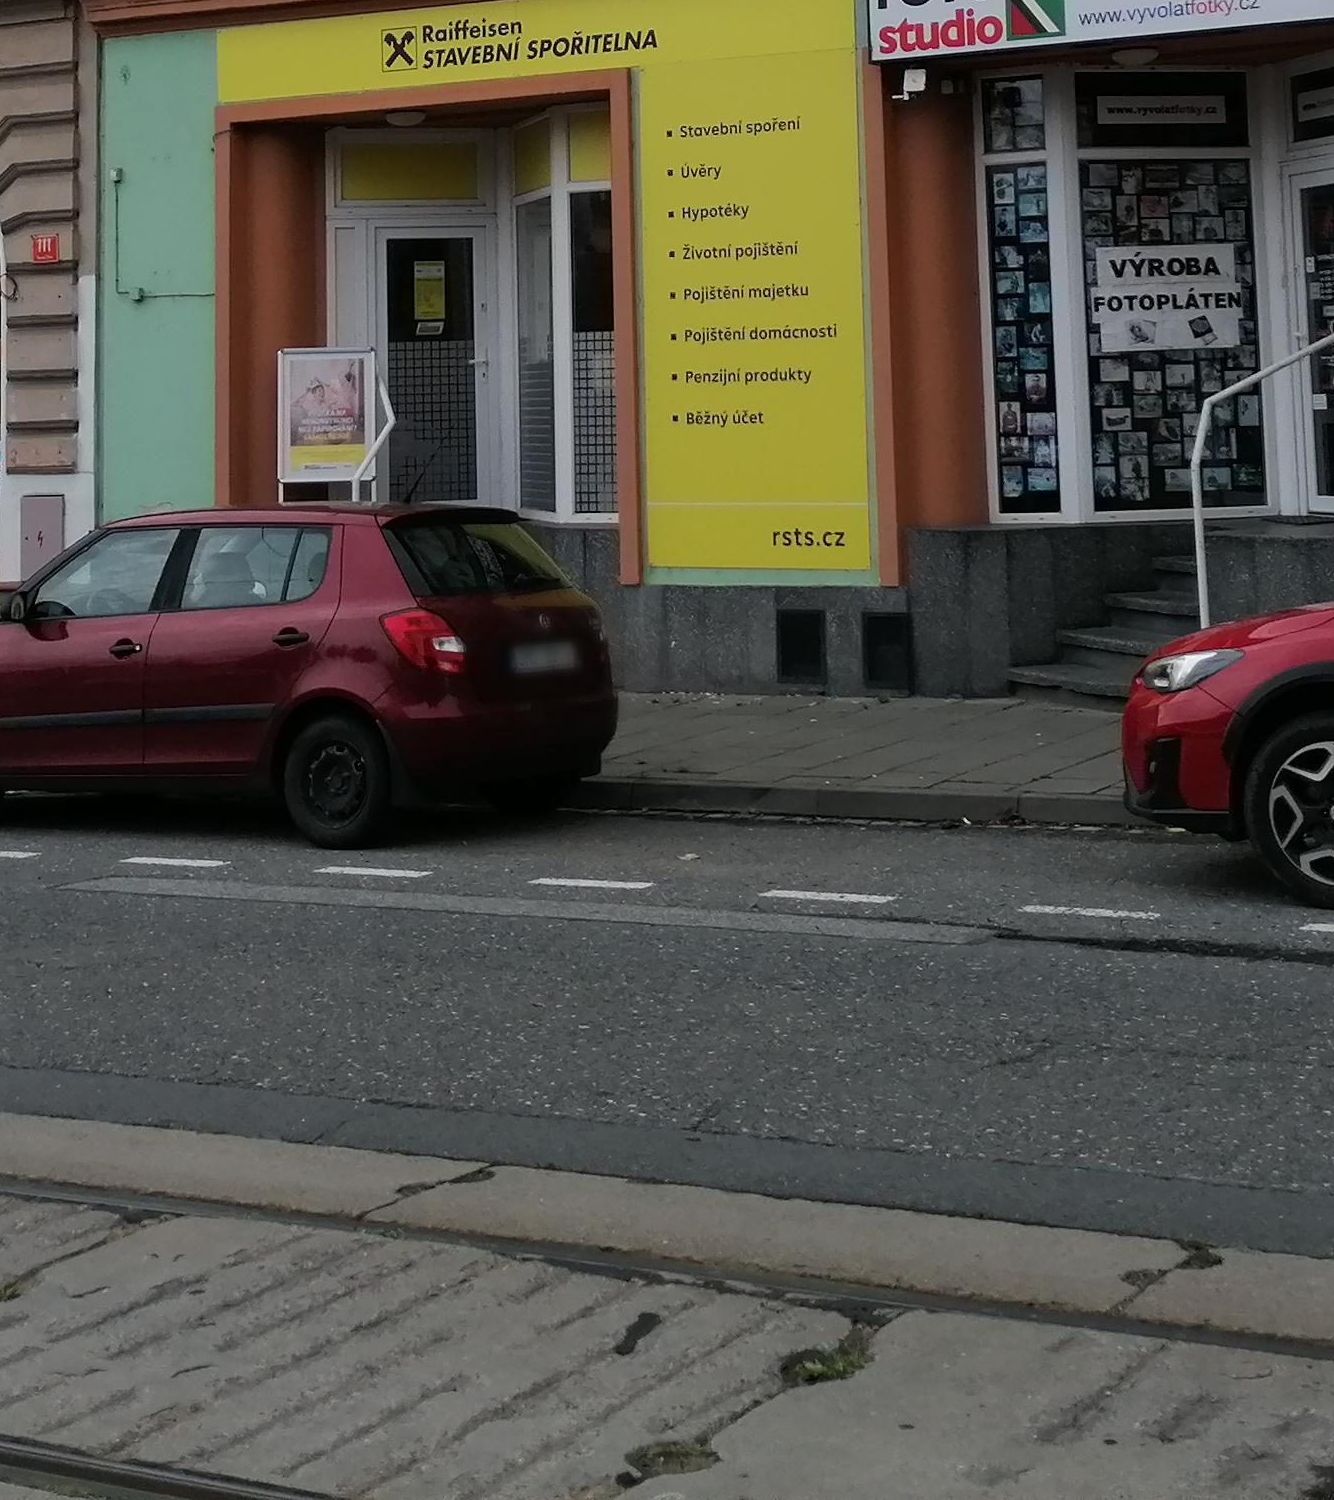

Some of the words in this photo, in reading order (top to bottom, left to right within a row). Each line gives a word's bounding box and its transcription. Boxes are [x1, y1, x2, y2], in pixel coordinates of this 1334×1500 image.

[422, 18, 522, 43] Raiffeisen
[878, 8, 1004, 54] studio
[423, 37, 520, 69] STAVEBNÍ
[526, 29, 658, 60] SPOŘITELNA
[679, 120, 742, 138] Stavební
[746, 116, 801, 136] spoření
[681, 162, 722, 179] Úvěry
[681, 203, 749, 222] Hypotéky
[682, 243, 731, 260] Životní
[735, 241, 798, 261] pojištění
[1108, 252, 1220, 278] VÝROBA
[683, 285, 744, 304] Pojištění
[748, 284, 809, 301] majetku
[1093, 288, 1242, 312] FOTOPLÁTEN
[684, 326, 746, 345] Pojištění
[749, 324, 837, 341] domácnosti
[685, 369, 741, 386] Penzijní
[744, 368, 812, 385] produkty
[686, 411, 728, 428] Běžný
[732, 410, 764, 424] účet
[772, 527, 845, 547] rsts.cz
